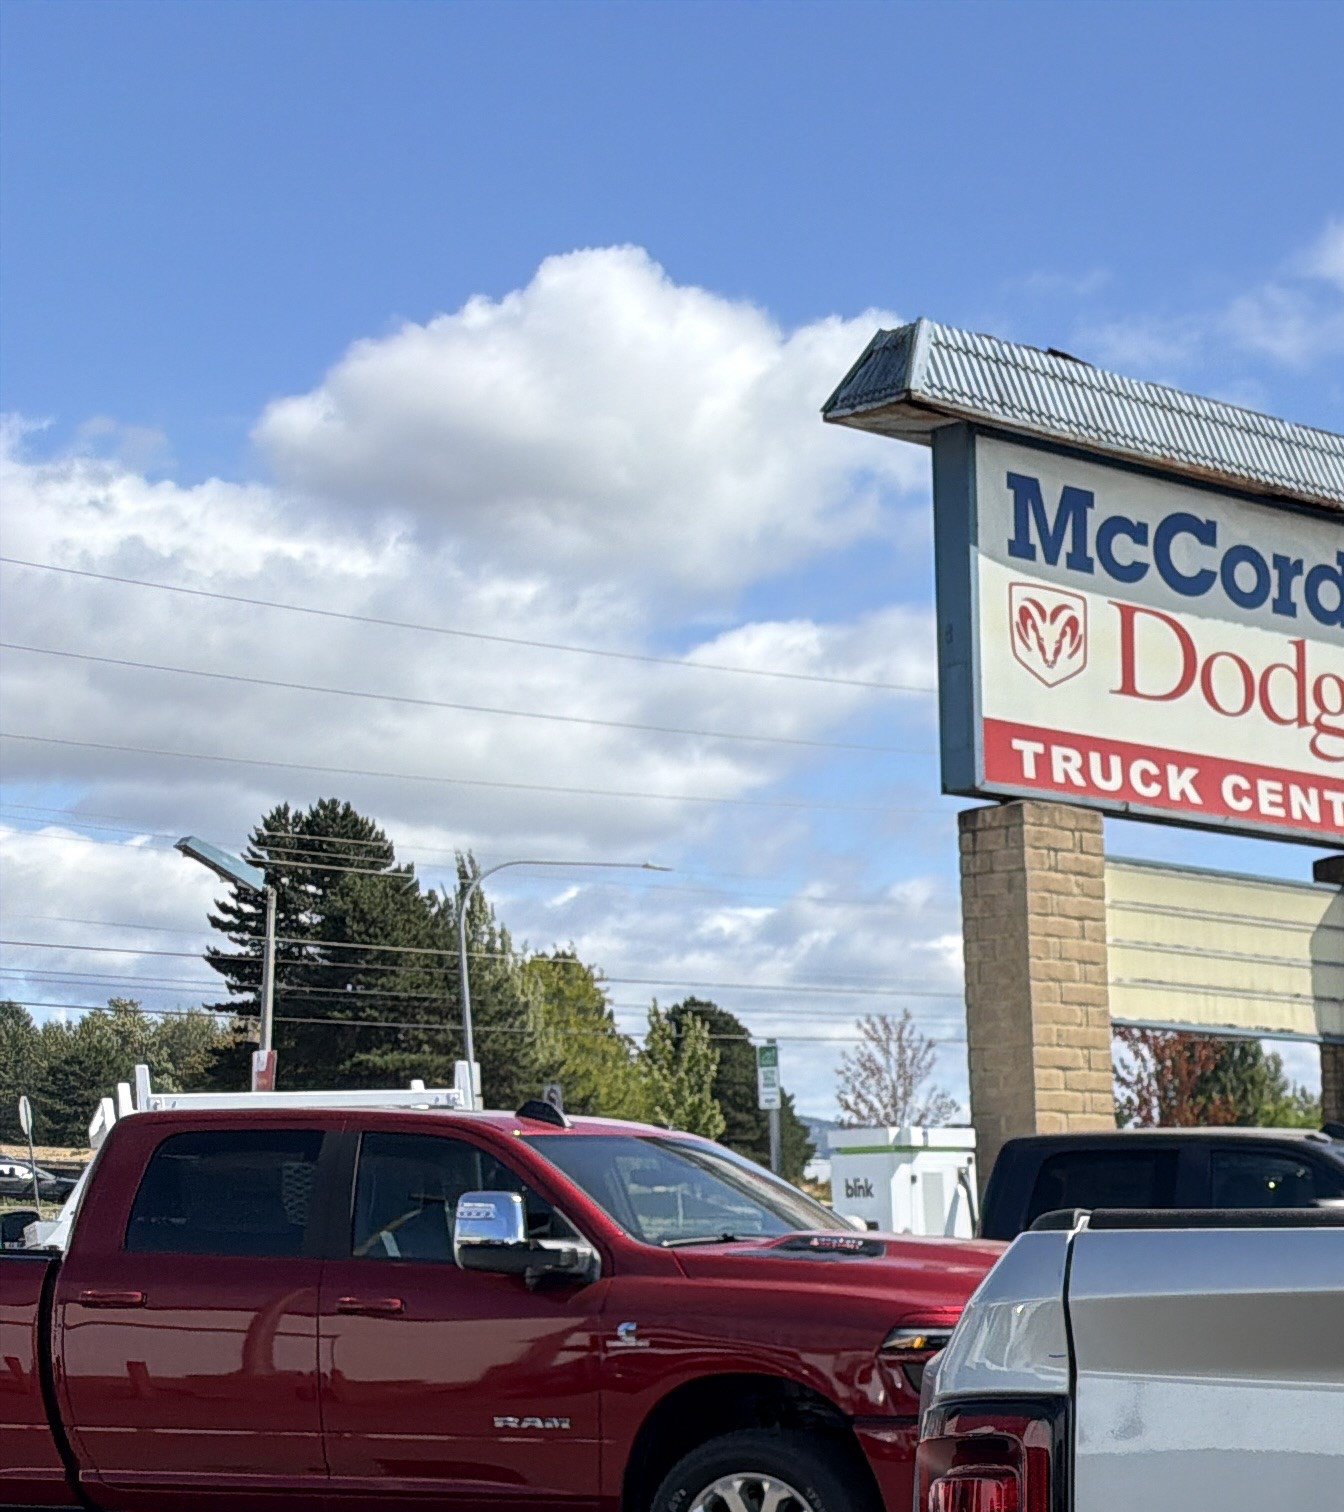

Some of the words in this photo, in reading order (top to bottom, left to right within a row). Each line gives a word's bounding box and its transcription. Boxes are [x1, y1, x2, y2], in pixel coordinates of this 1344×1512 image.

[1011, 738, 1203, 806] TRUCK
[844, 1177, 874, 1198] blink
[493, 1416, 571, 1430] RAM
